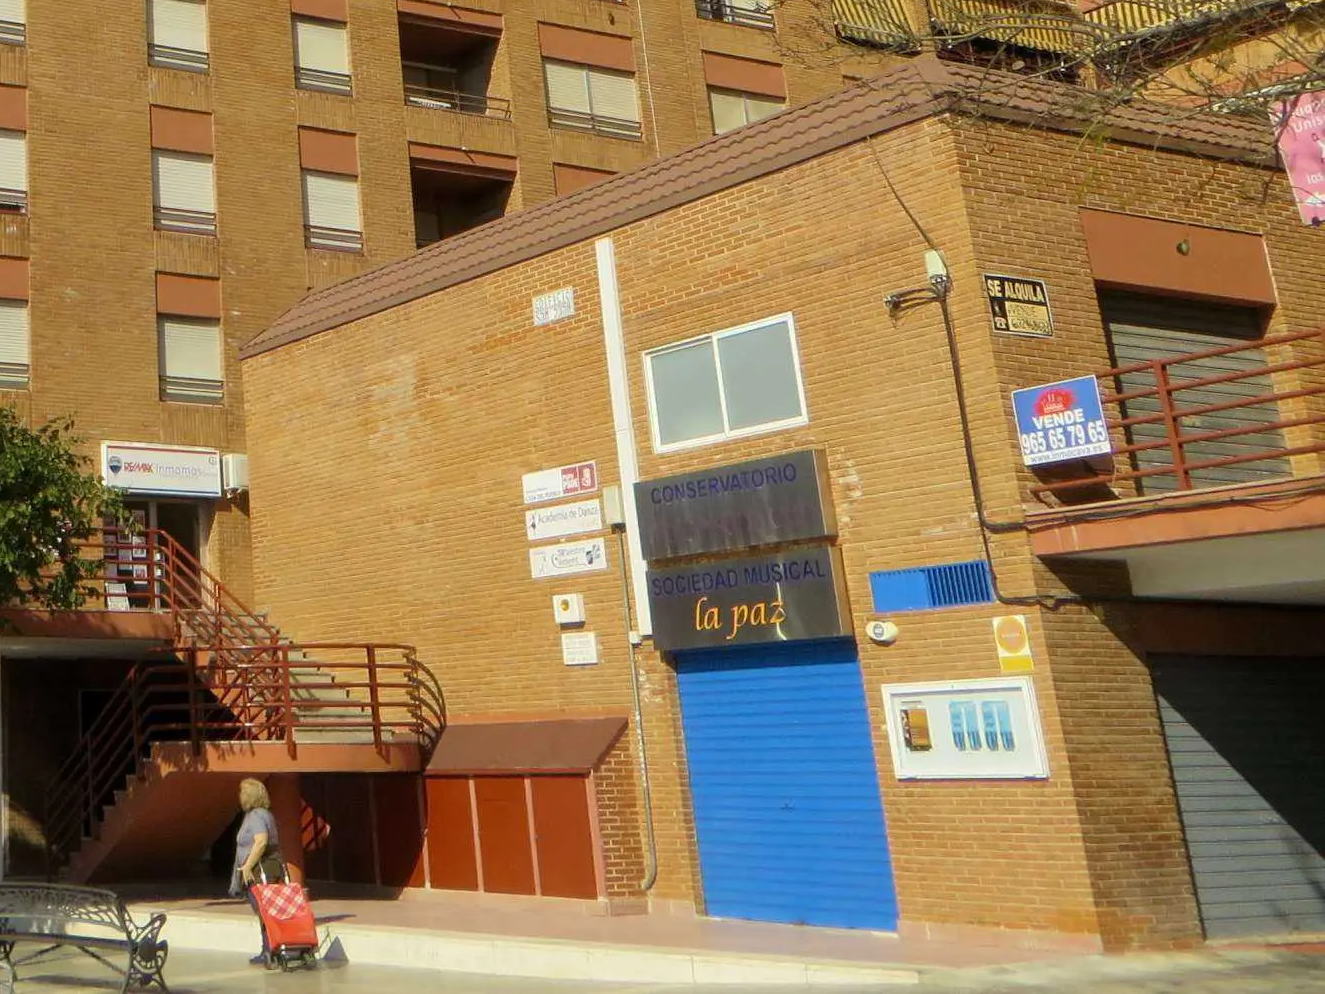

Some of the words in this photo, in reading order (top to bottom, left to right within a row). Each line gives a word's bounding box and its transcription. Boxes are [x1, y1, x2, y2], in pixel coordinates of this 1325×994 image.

[987, 279, 1002, 297] SE
[1004, 281, 1045, 303] ALQUILA
[1032, 408, 1085, 430] VENDE
[1022, 431, 1046, 454] 965
[1048, 427, 1066, 449] 65
[1067, 424, 1086, 445] 79
[1087, 420, 1106, 442] 65
[651, 463, 797, 504] CONSERVATORIO
[539, 511, 568, 525] Academia
[569, 506, 578, 518] de
[652, 569, 738, 597] SOCIEDAD
[744, 559, 825, 584] MUSICAL
[695, 597, 722, 631] la
[727, 599, 787, 640] paz
